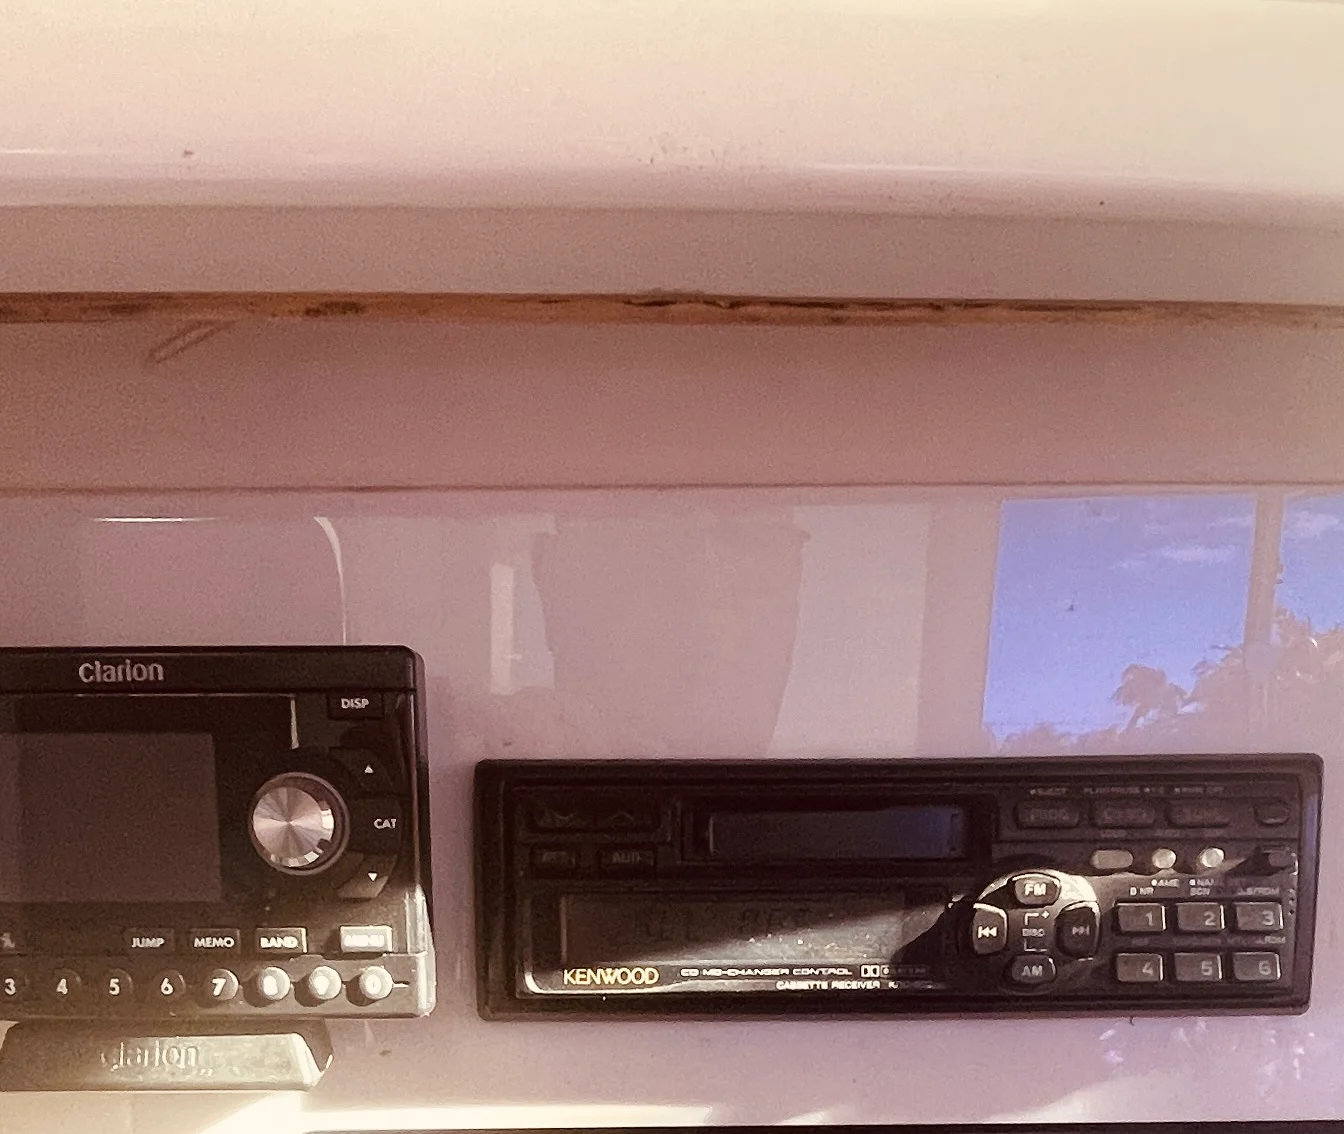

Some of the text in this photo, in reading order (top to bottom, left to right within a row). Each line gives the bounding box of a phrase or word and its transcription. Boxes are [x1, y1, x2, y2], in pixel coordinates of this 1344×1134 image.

[78, 659, 164, 683] Clarion
[341, 698, 369, 709] DISP
[374, 818, 397, 830] CAT
[1024, 884, 1047, 897] FM
[1144, 911, 1154, 926] 1
[1203, 911, 1216, 926] 2
[1261, 910, 1274, 926] 3
[131, 937, 165, 948] JUMP
[194, 937, 235, 948] MEMO
[260, 937, 299, 948] BAND
[792, 968, 853, 977] CONTROL
[1021, 964, 1043, 977] AM
[1142, 962, 1154, 976] 4
[1200, 961, 1213, 976] 5
[1258, 961, 1271, 976] 6
[563, 966, 659, 986] KENWOOD
[5, 977, 16, 995] 3
[56, 978, 68, 995] 4
[109, 978, 120, 996] 5
[160, 977, 174, 995] 6
[212, 978, 226, 997] 7
[831, 980, 881, 990] RECEIVER
